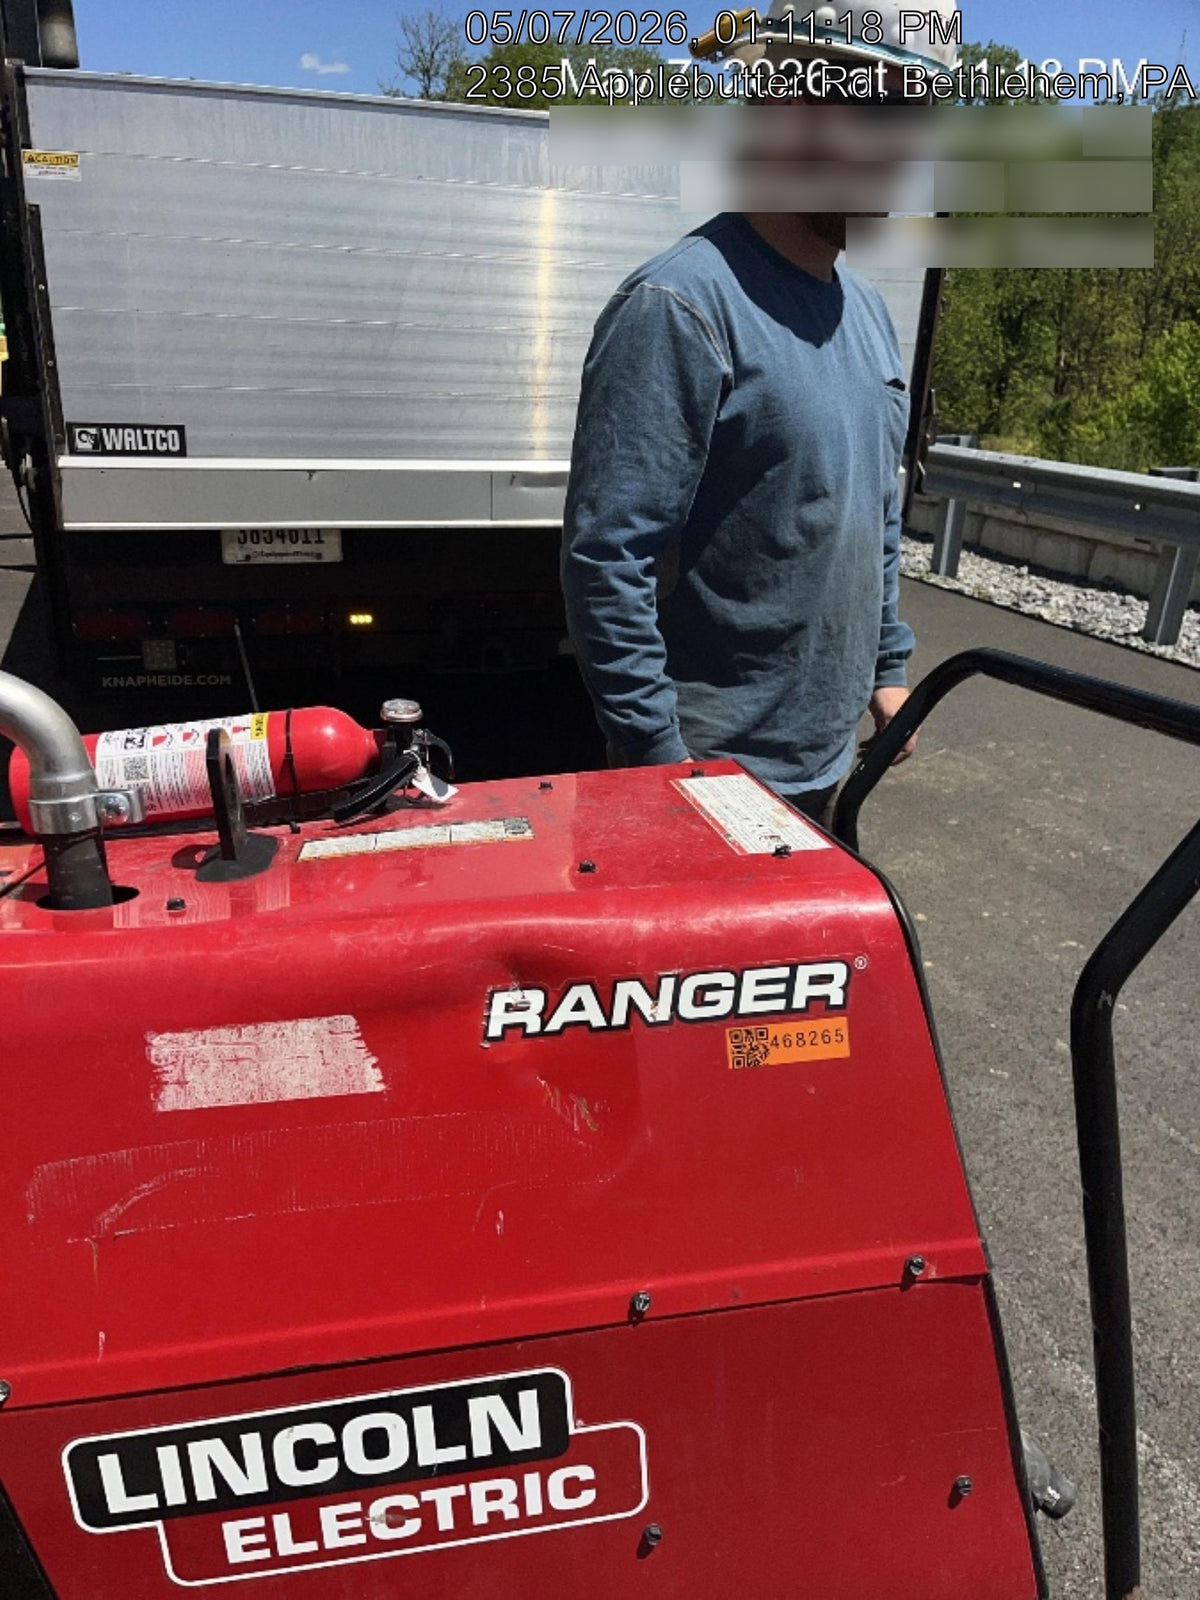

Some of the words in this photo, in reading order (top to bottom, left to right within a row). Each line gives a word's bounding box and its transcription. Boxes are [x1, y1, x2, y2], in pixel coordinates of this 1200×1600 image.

[101, 427, 180, 451] WALTCO
[101, 674, 232, 688] KNAPHEIDE.COM
[486, 960, 848, 1039] RANGER
[769, 1028, 844, 1048] 468265
[97, 1389, 542, 1514] LINCOLN
[221, 1464, 597, 1564] ELECTRIC
